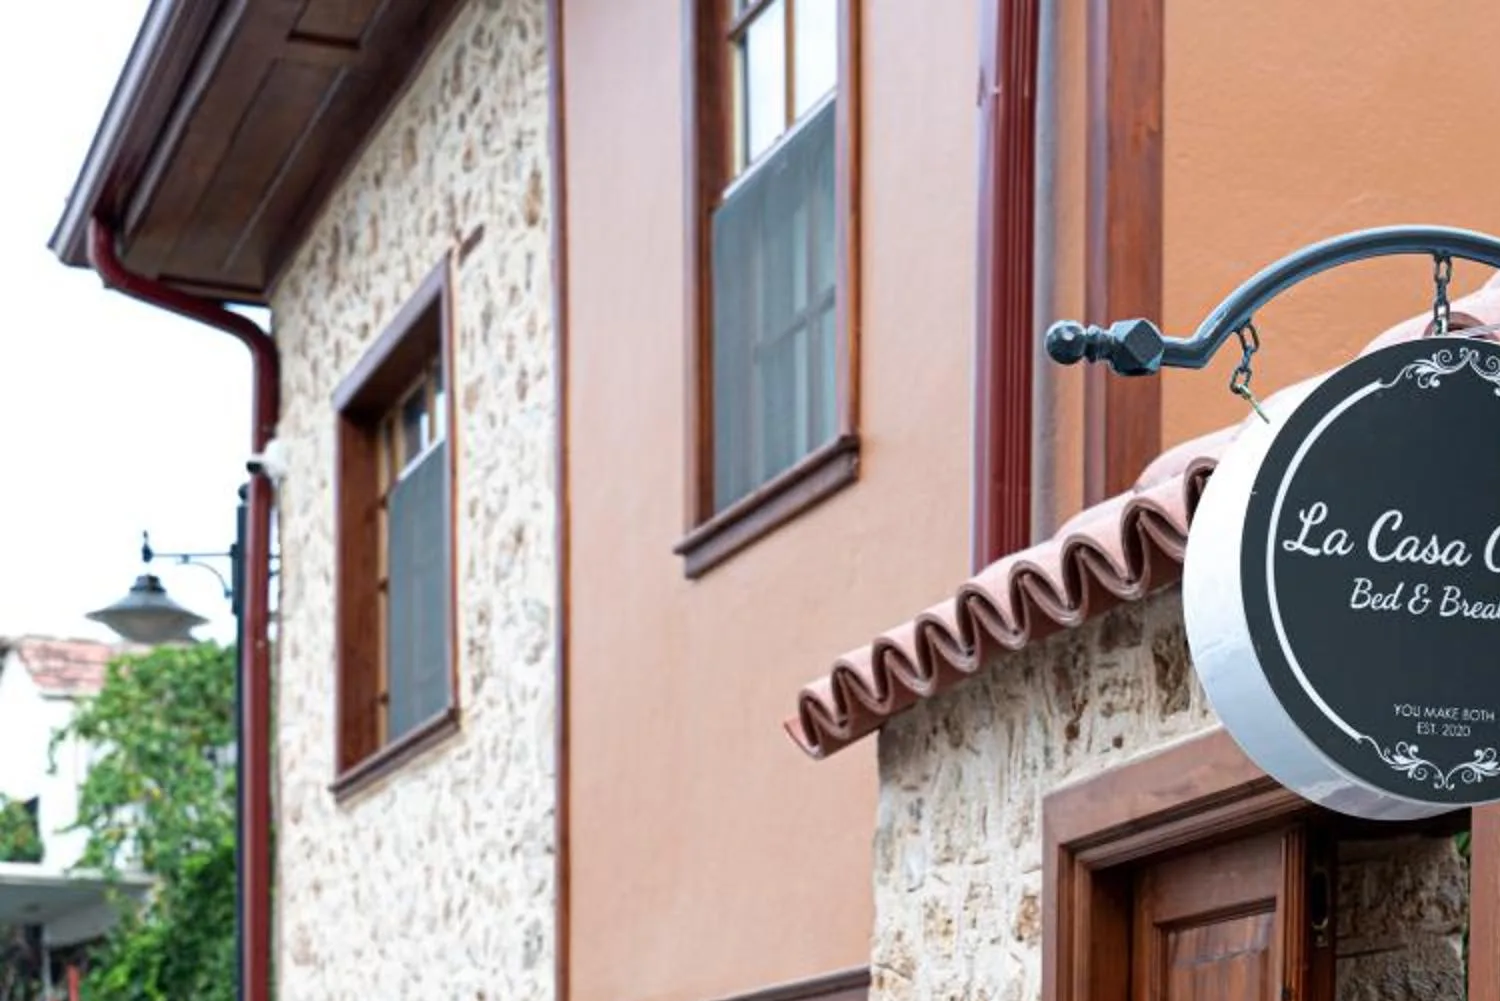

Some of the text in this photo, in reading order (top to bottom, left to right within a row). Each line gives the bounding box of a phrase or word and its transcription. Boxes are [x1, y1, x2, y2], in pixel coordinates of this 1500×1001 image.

[1281, 501, 1354, 557] La
[1367, 509, 1472, 567] Casa
[1350, 577, 1404, 611] Bed
[1407, 584, 1431, 615] &
[1393, 703, 1495, 721] YOU MAKE BOTH
[1442, 723, 1471, 737] 2020
